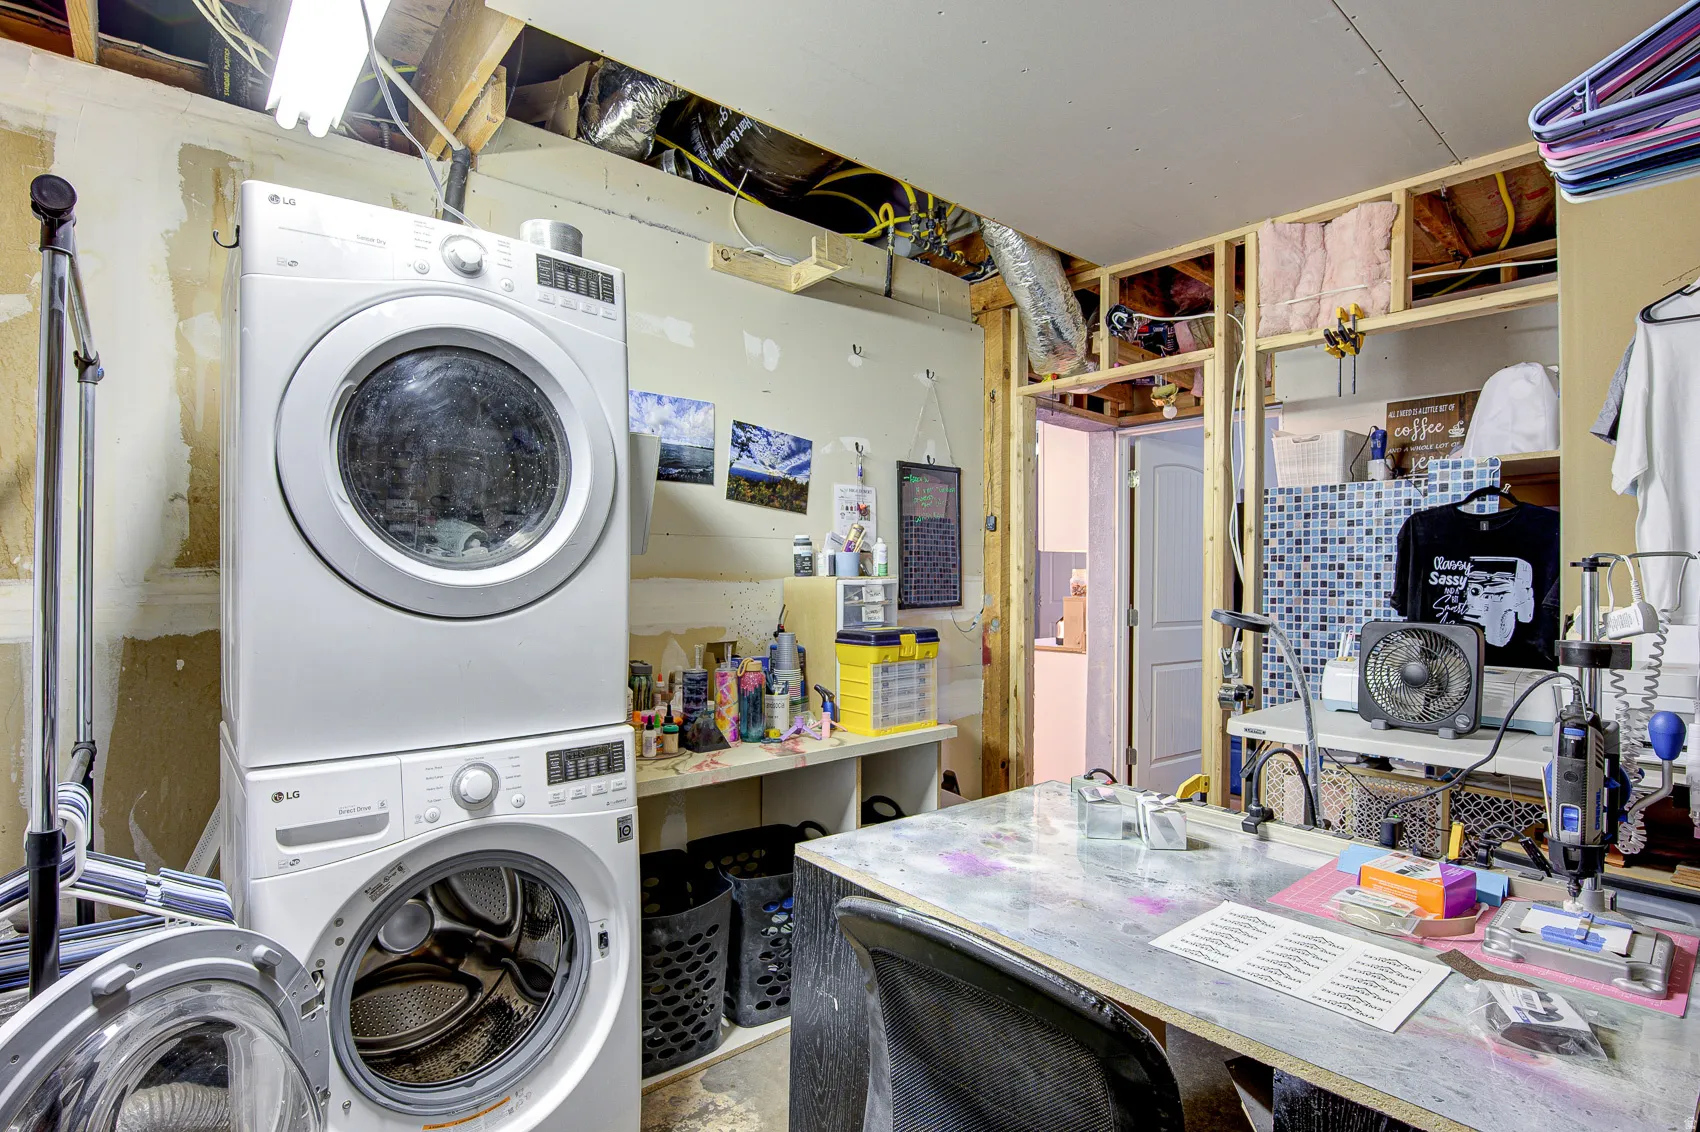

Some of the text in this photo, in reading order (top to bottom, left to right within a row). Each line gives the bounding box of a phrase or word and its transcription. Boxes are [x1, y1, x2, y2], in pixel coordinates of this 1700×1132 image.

[736, 116, 752, 136] Hart
[730, 130, 740, 142] &
[282, 198, 296, 206] LG
[356, 234, 386, 246] Sensor Dry
[1400, 409, 1412, 417] NEED
[1422, 406, 1438, 414] LITTLE
[1394, 417, 1444, 441] coffee
[1434, 556, 1474, 575] Classy
[1428, 572, 1468, 590] Sassy
[1433, 594, 1468, 617] Smart
[286, 791, 300, 800] LG
[619, 824, 631, 838] 10
